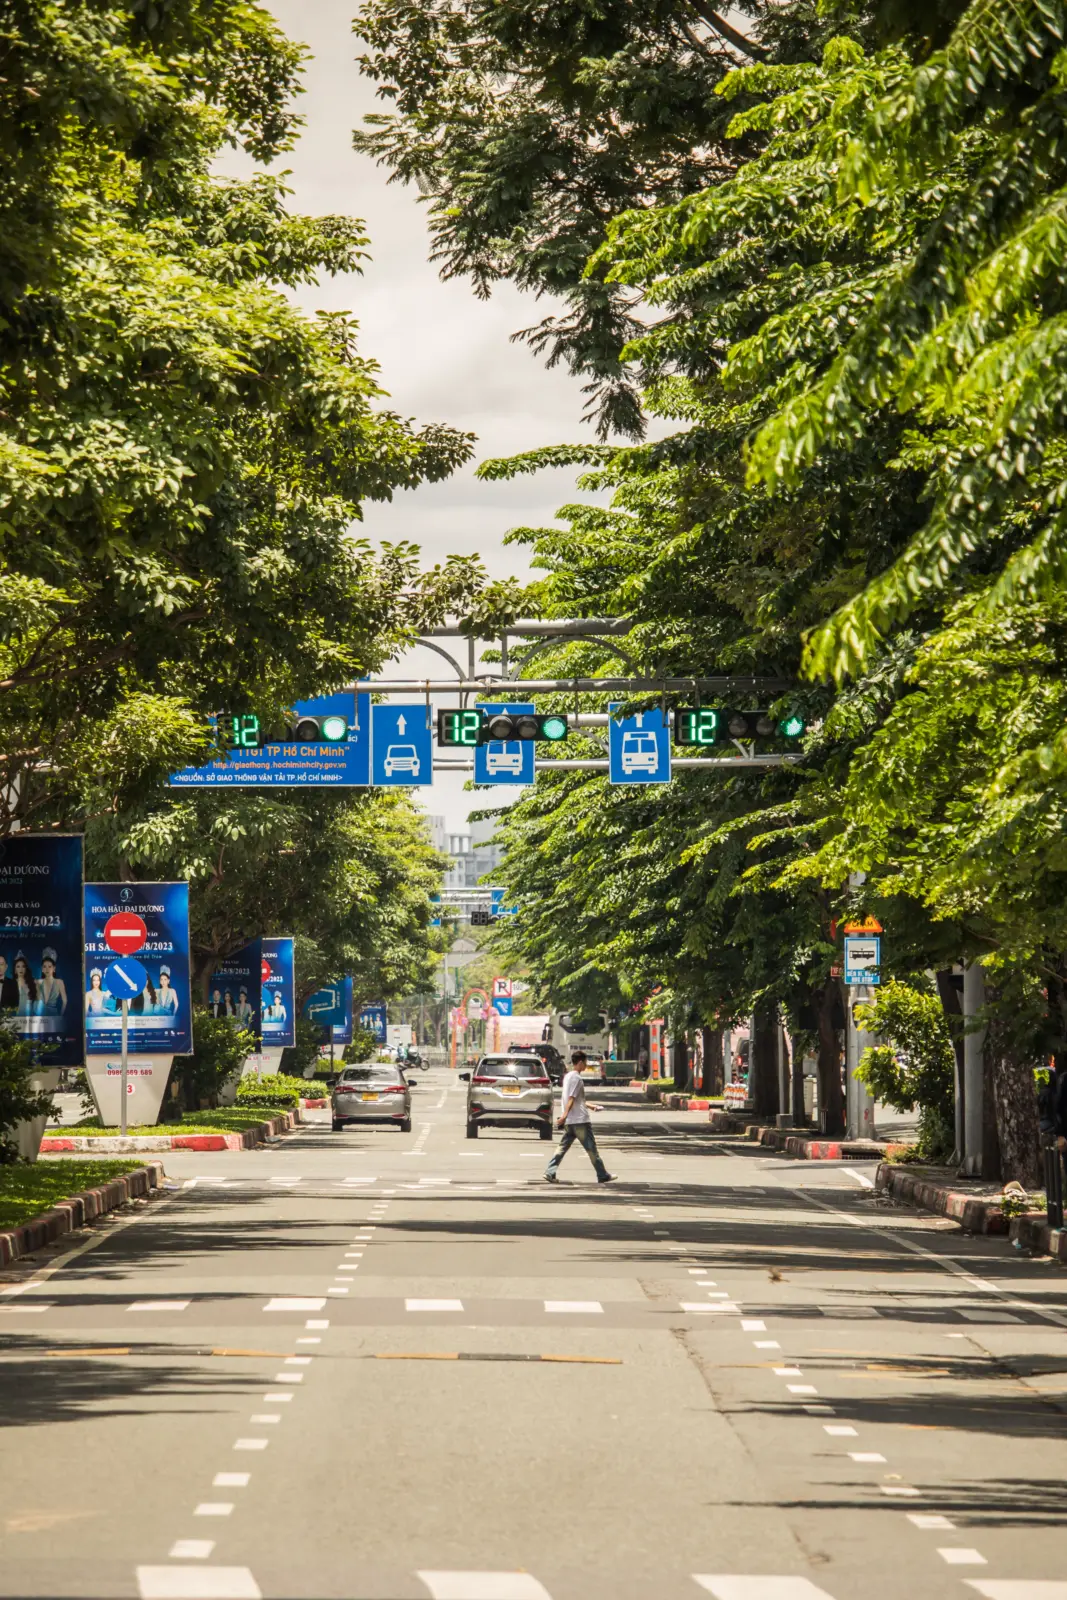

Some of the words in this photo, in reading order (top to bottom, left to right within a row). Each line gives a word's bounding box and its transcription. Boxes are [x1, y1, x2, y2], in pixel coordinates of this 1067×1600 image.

[233, 715, 259, 746] 12
[455, 713, 480, 744] 12
[691, 712, 716, 743] 12
[267, 746, 281, 757] TP
[300, 745, 316, 757] Chí
[217, 774, 233, 782] GIAO
[234, 773, 257, 782] THÔNG
[258, 773, 273, 783] VẬN
[308, 772, 320, 782] CHÍ
[14, 864, 50, 875] DƯƠNG
[25, 901, 40, 909] VÀO
[107, 904, 124, 914] HẬU
[125, 905, 138, 913] ĐẠI
[138, 905, 165, 913] DƯƠNG
[5, 915, 61, 927] 25/8/2023
